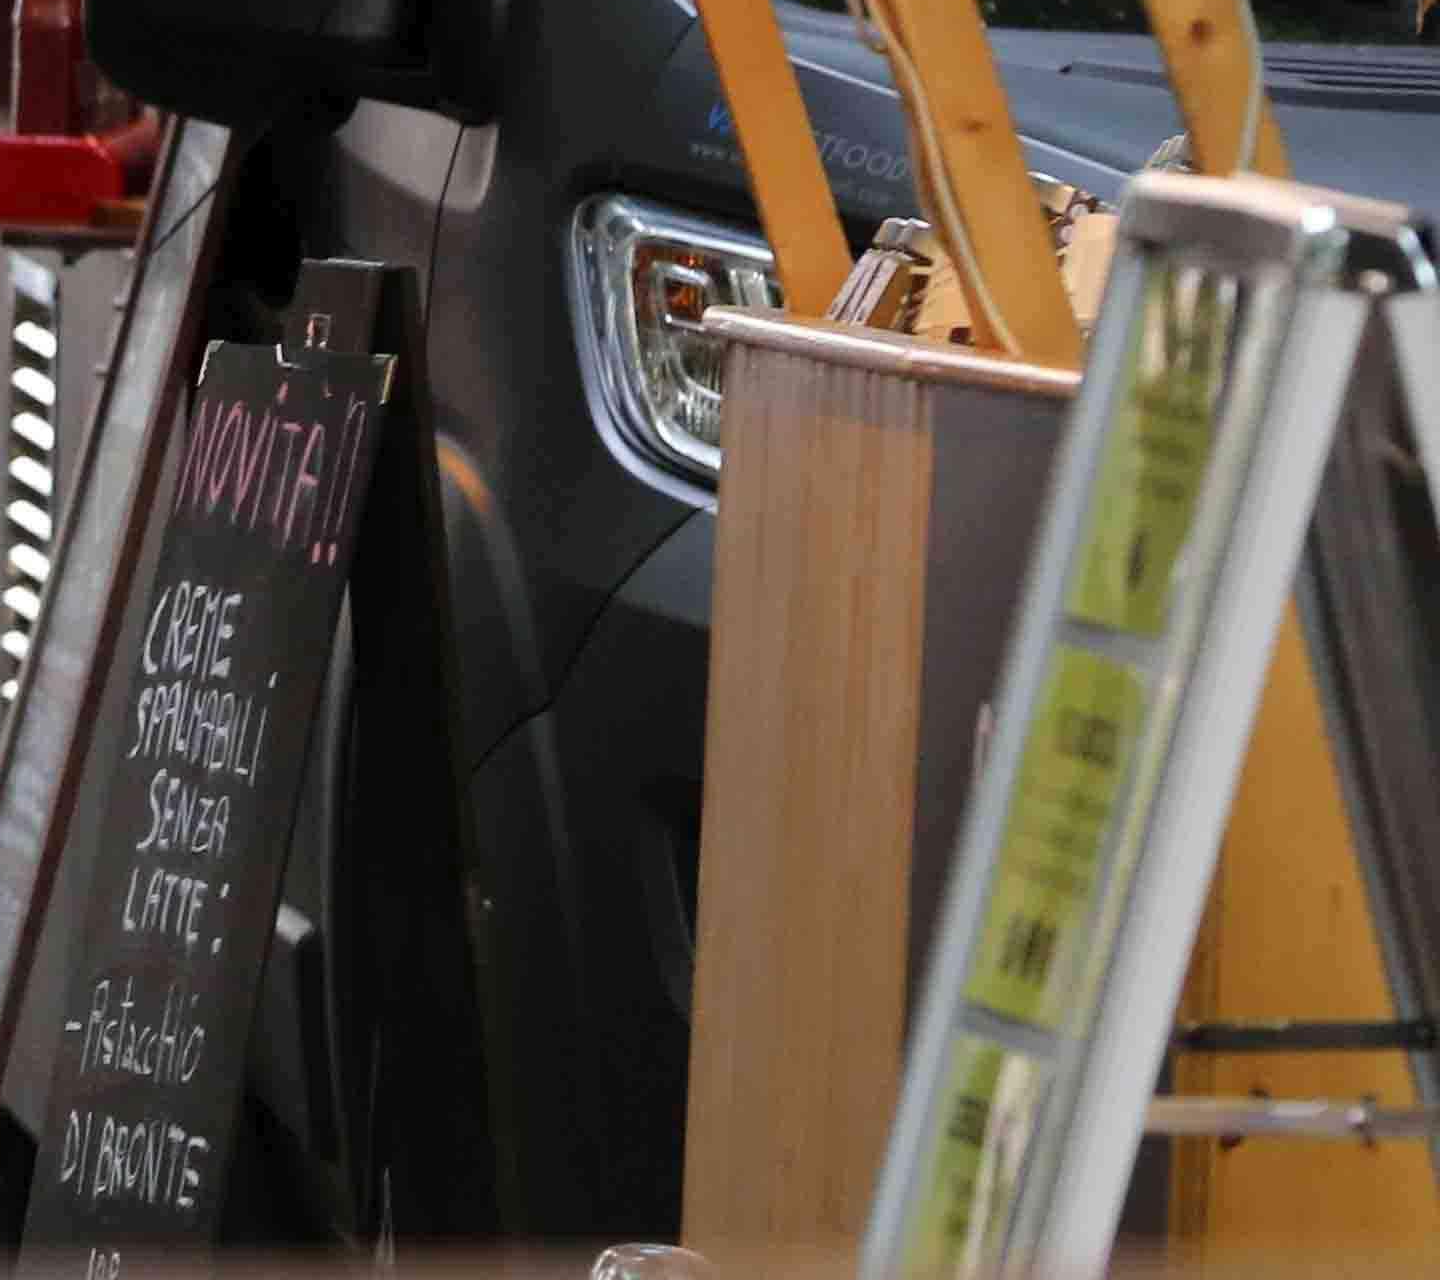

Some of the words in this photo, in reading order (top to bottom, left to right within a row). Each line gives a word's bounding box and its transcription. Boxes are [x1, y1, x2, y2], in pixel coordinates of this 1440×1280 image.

[143, 581, 244, 683] CREME
[136, 768, 230, 859] SENZA
[60, 1109, 94, 1195] DI
[93, 1116, 211, 1207] BRONTE
